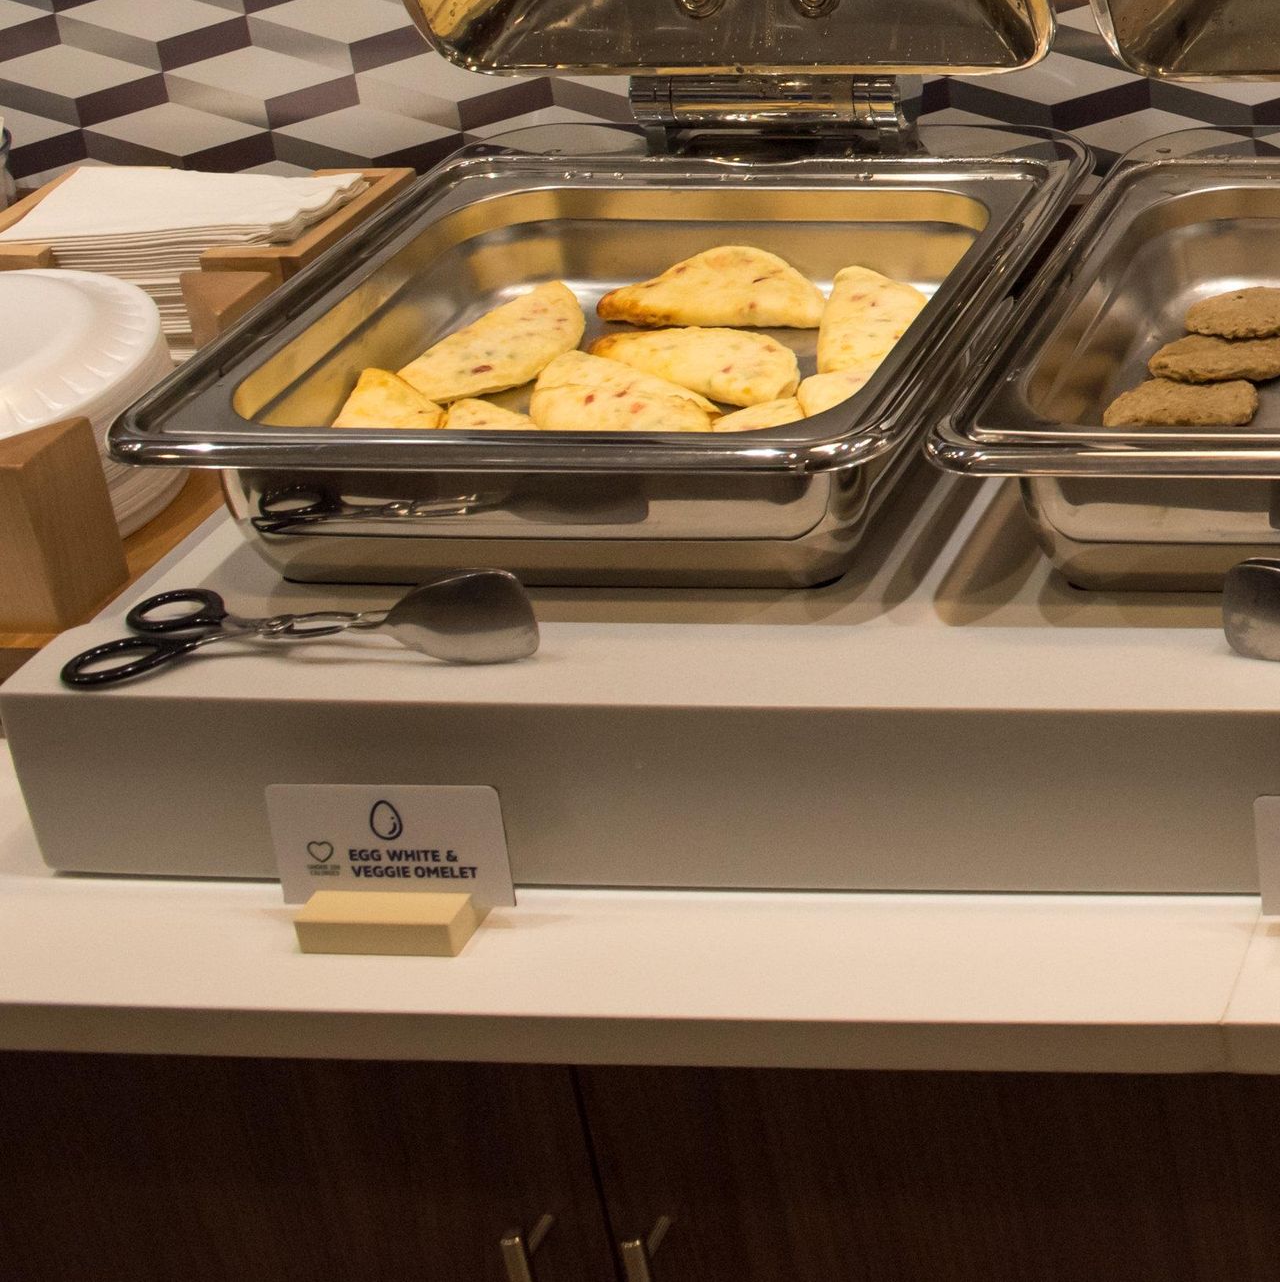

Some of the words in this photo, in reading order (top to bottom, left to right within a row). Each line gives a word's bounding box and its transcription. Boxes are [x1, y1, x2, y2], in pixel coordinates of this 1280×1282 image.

[348, 848, 382, 862] EGG
[385, 849, 441, 863] WHITE
[445, 849, 459, 863] &
[350, 864, 412, 879] VEGGIE
[413, 865, 478, 879] OMELET
